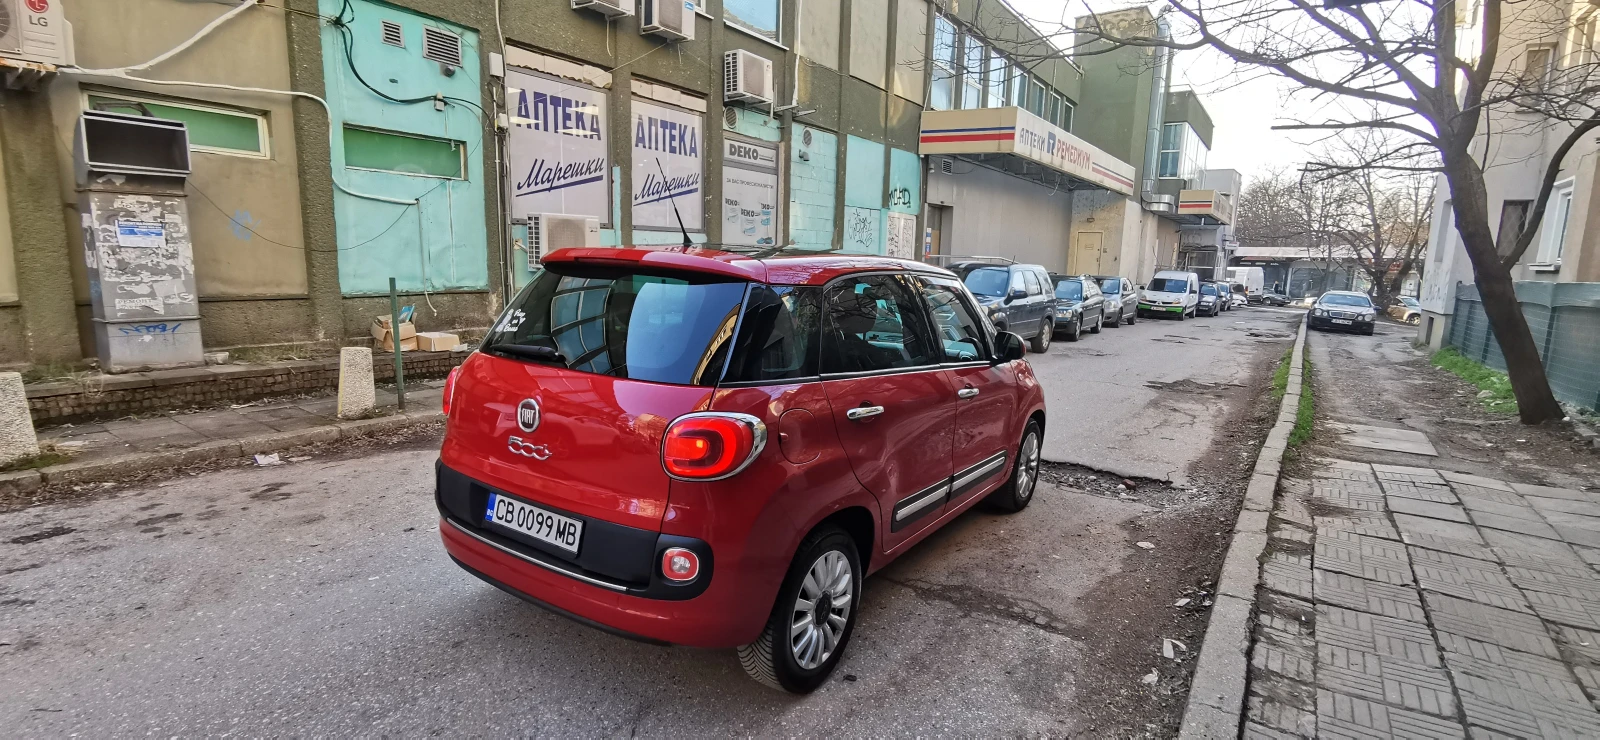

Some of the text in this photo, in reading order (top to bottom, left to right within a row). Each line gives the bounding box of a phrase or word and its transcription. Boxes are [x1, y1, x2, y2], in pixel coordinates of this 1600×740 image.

[28, 14, 48, 27] LG
[516, 88, 602, 141] АПТЕКА
[635, 114, 699, 158] АПТЕКА
[729, 143, 759, 161] DEKO
[1019, 127, 1046, 152] АПТЕКИ
[516, 157, 605, 193] Марешки
[634, 171, 700, 203] Марешки
[521, 408, 535, 425] FIAT
[517, 506, 554, 538] 0099
